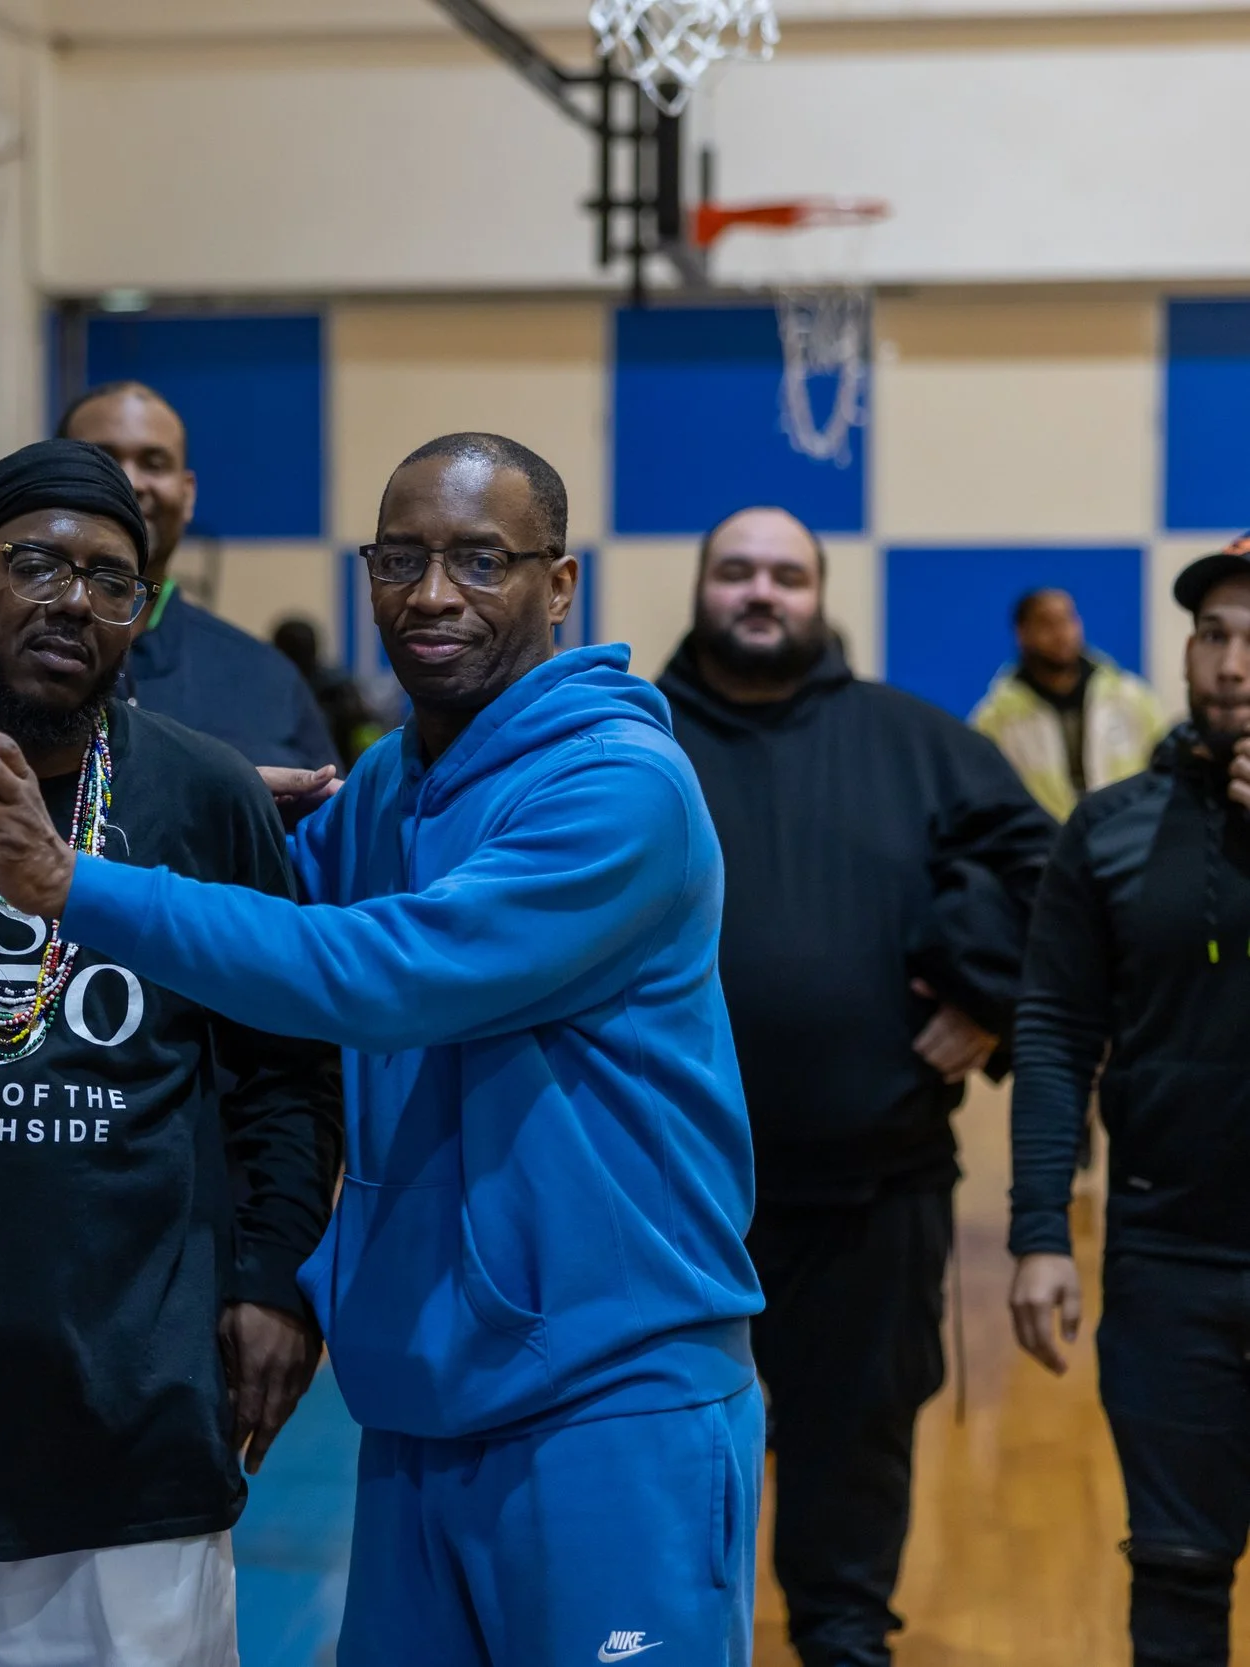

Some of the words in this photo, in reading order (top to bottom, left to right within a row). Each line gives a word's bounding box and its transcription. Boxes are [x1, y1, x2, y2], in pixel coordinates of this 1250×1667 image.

[1, 1082, 51, 1106] OF
[64, 1084, 127, 1110] THE
[606, 1630, 646, 1650] NIKE
